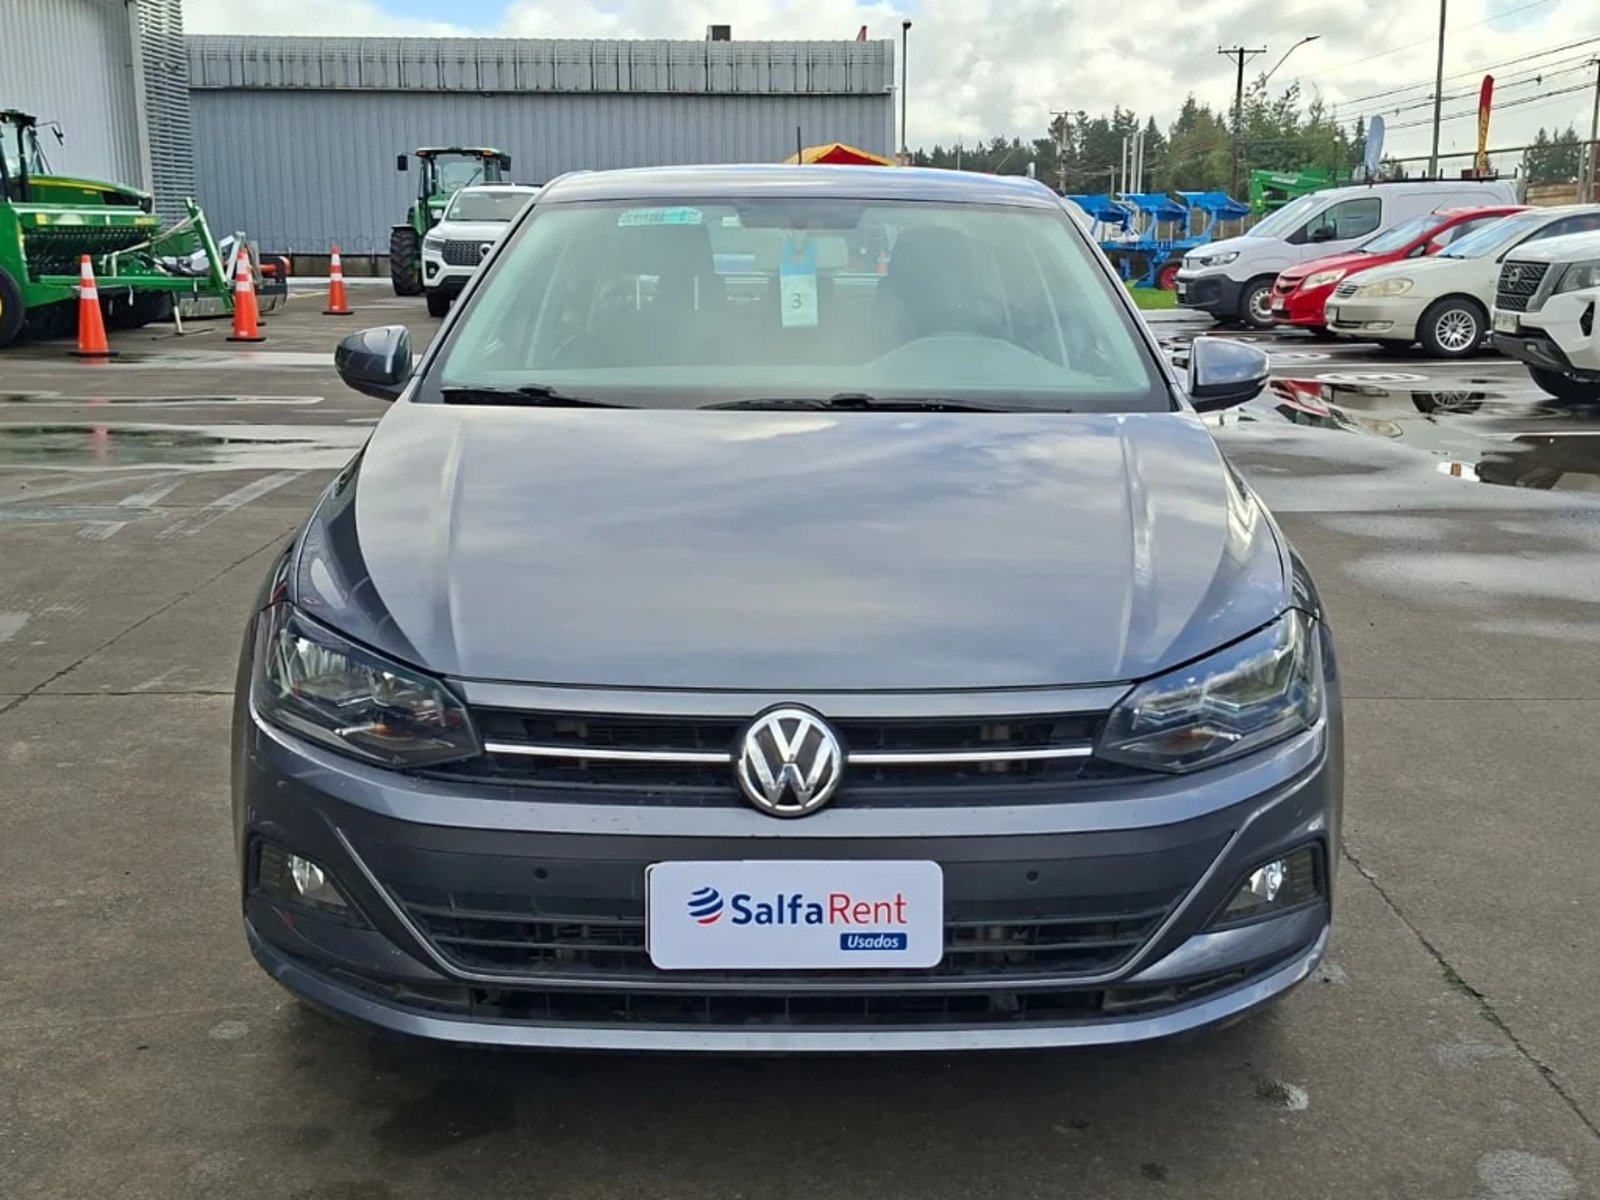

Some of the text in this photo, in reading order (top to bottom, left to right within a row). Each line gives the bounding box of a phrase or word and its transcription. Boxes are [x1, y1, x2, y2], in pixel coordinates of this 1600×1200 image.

[791, 292, 802, 309] 3
[731, 893, 907, 925] SalfaRent
[847, 934, 900, 949] Usados
